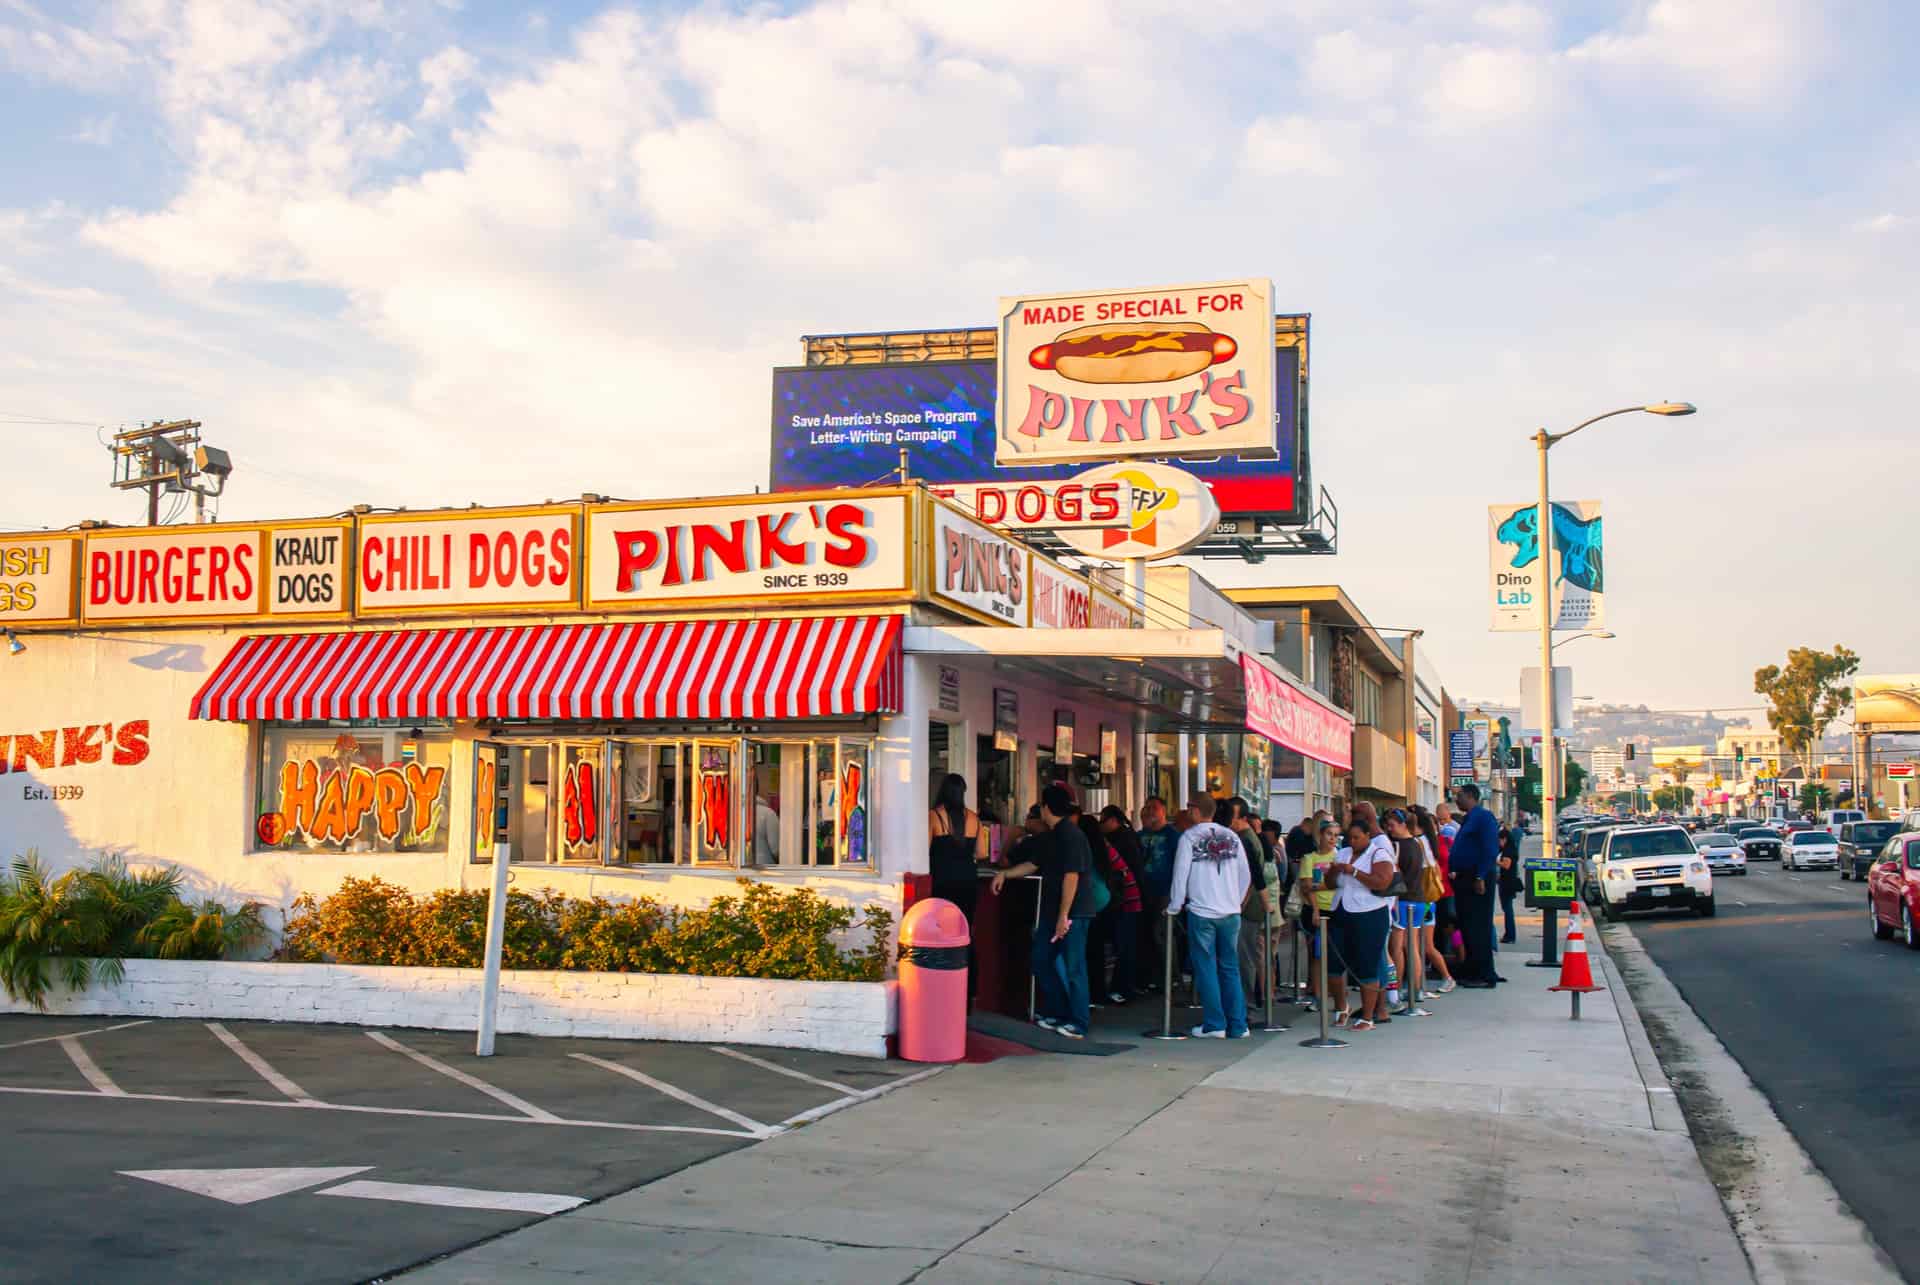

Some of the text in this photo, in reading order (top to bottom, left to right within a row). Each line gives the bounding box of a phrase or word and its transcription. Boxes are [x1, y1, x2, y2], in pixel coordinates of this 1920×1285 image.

[1023, 294, 1244, 325] MADE SPECIAL FOR
[792, 410, 977, 428] Save America's Space Program
[1017, 369, 1254, 443] PINK'S
[810, 427, 957, 445] Letter-Writing Campaign
[975, 483, 1120, 524] DOGS
[275, 536, 339, 566] KRAUT
[362, 528, 571, 592] CHILI DOGS
[613, 504, 879, 593] PINK'S
[90, 543, 254, 605] BURGERS
[763, 573, 848, 588] SINCE 1939
[943, 525, 1023, 606] PINK'S
[1497, 573, 1532, 585] Dino
[277, 573, 334, 603] DOGS
[1497, 588, 1532, 605] Lab
[24, 786, 84, 800] Est. 1939
[280, 759, 446, 844] HAPPY
